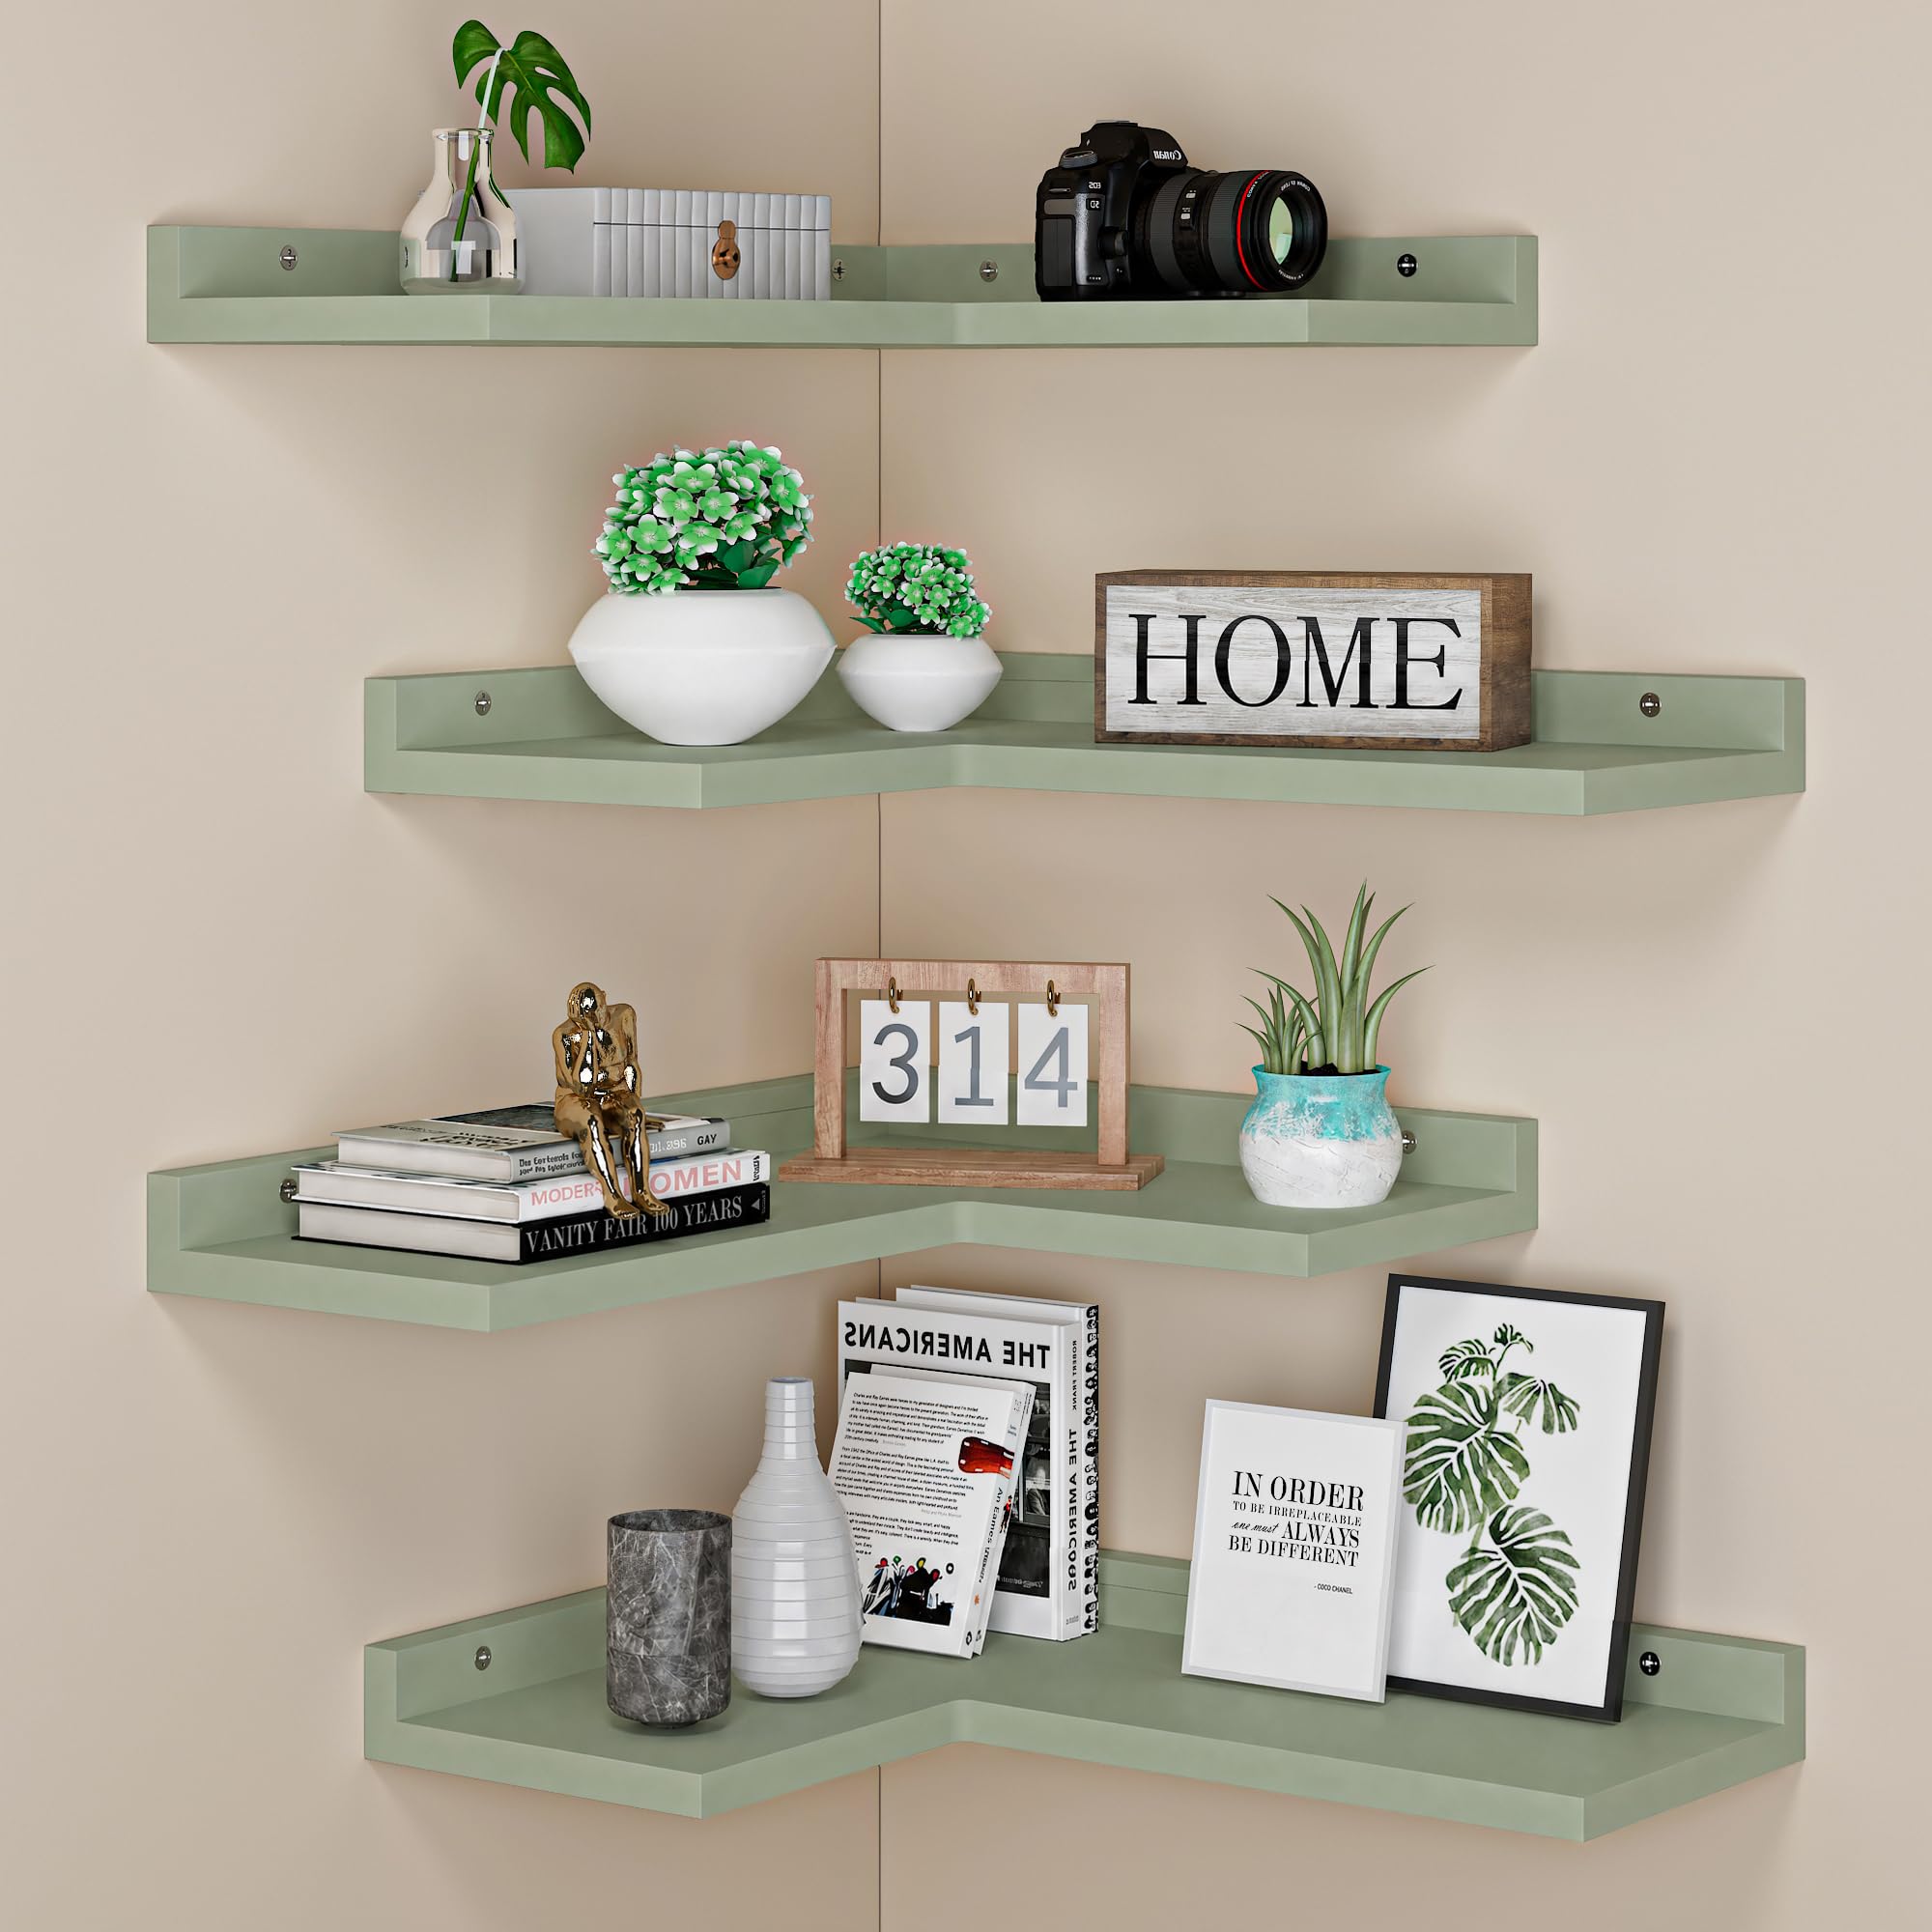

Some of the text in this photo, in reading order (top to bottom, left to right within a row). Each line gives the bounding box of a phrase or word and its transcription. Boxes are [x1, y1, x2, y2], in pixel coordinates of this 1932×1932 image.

[1127, 613, 1463, 710] HOME
[872, 1023, 1078, 1108] 3 1 4
[697, 1133, 718, 1146] GAY
[623, 1158, 742, 1196] OMEN
[526, 1220, 599, 1253] VANITY
[604, 1213, 647, 1241] FAIR
[653, 1207, 678, 1233] 100
[683, 1195, 743, 1226] YEARS
[1232, 1470, 1364, 1512] IN ORDER
[1233, 1500, 1362, 1527] TO BE IRREPLACEABLE
[1228, 1534, 1359, 1567] BE DIFFERENT
[1251, 1522, 1279, 1534] must
[1281, 1520, 1359, 1548] ALWAYS
[1317, 1582, 1331, 1592] COCO
[1332, 1584, 1353, 1595] CHANEL
